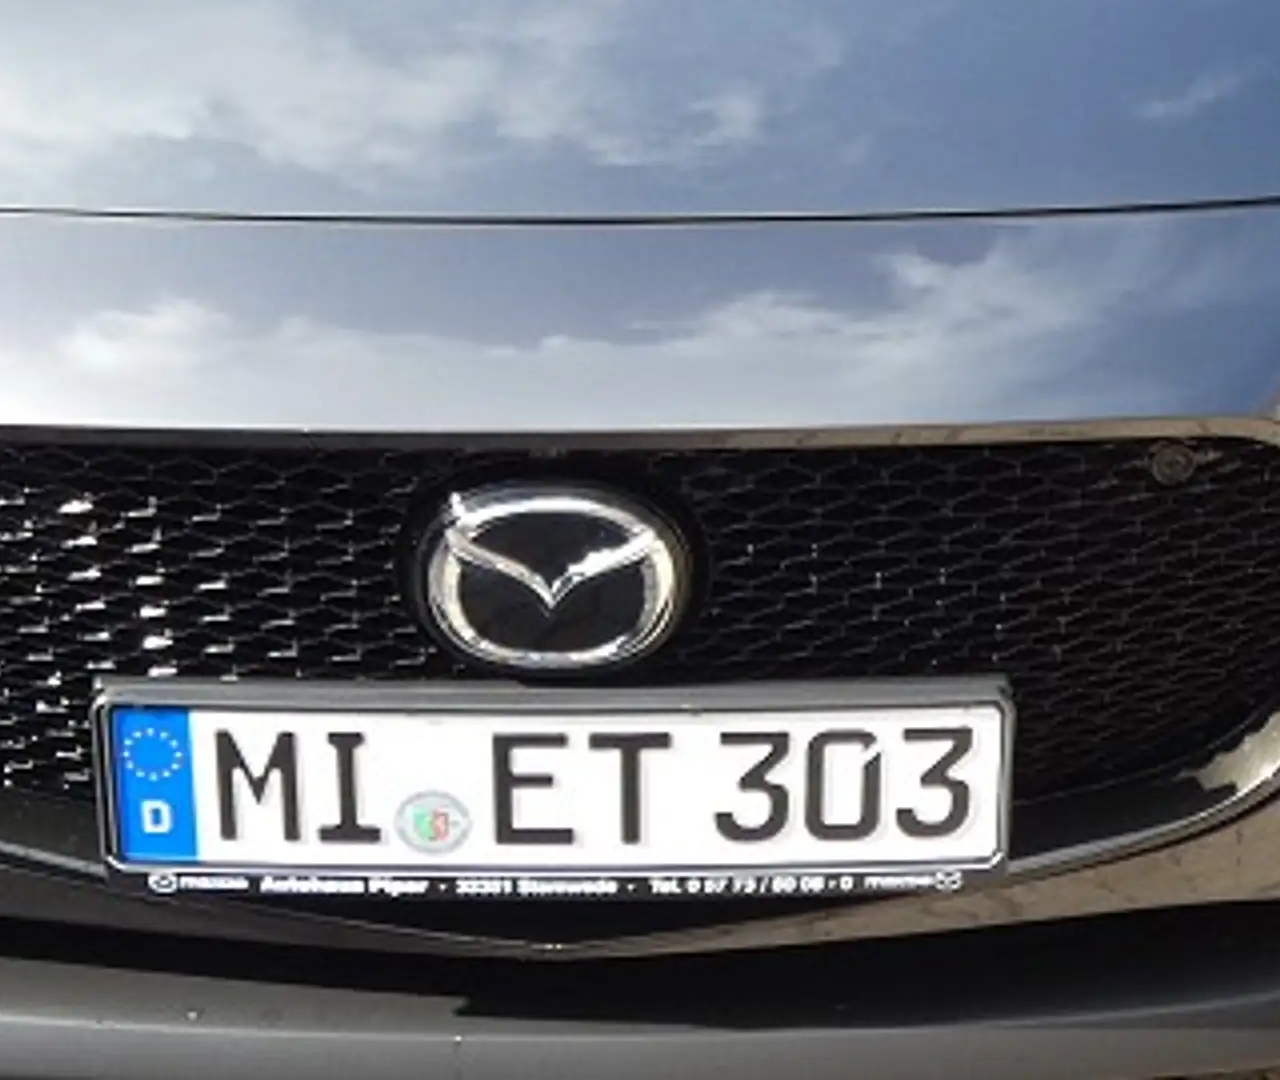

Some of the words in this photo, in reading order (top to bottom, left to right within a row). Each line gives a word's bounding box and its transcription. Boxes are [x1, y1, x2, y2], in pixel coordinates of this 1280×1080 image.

[140, 799, 174, 835] D
[214, 727, 383, 844] MI
[492, 732, 673, 846] ET
[713, 726, 974, 843] 303
